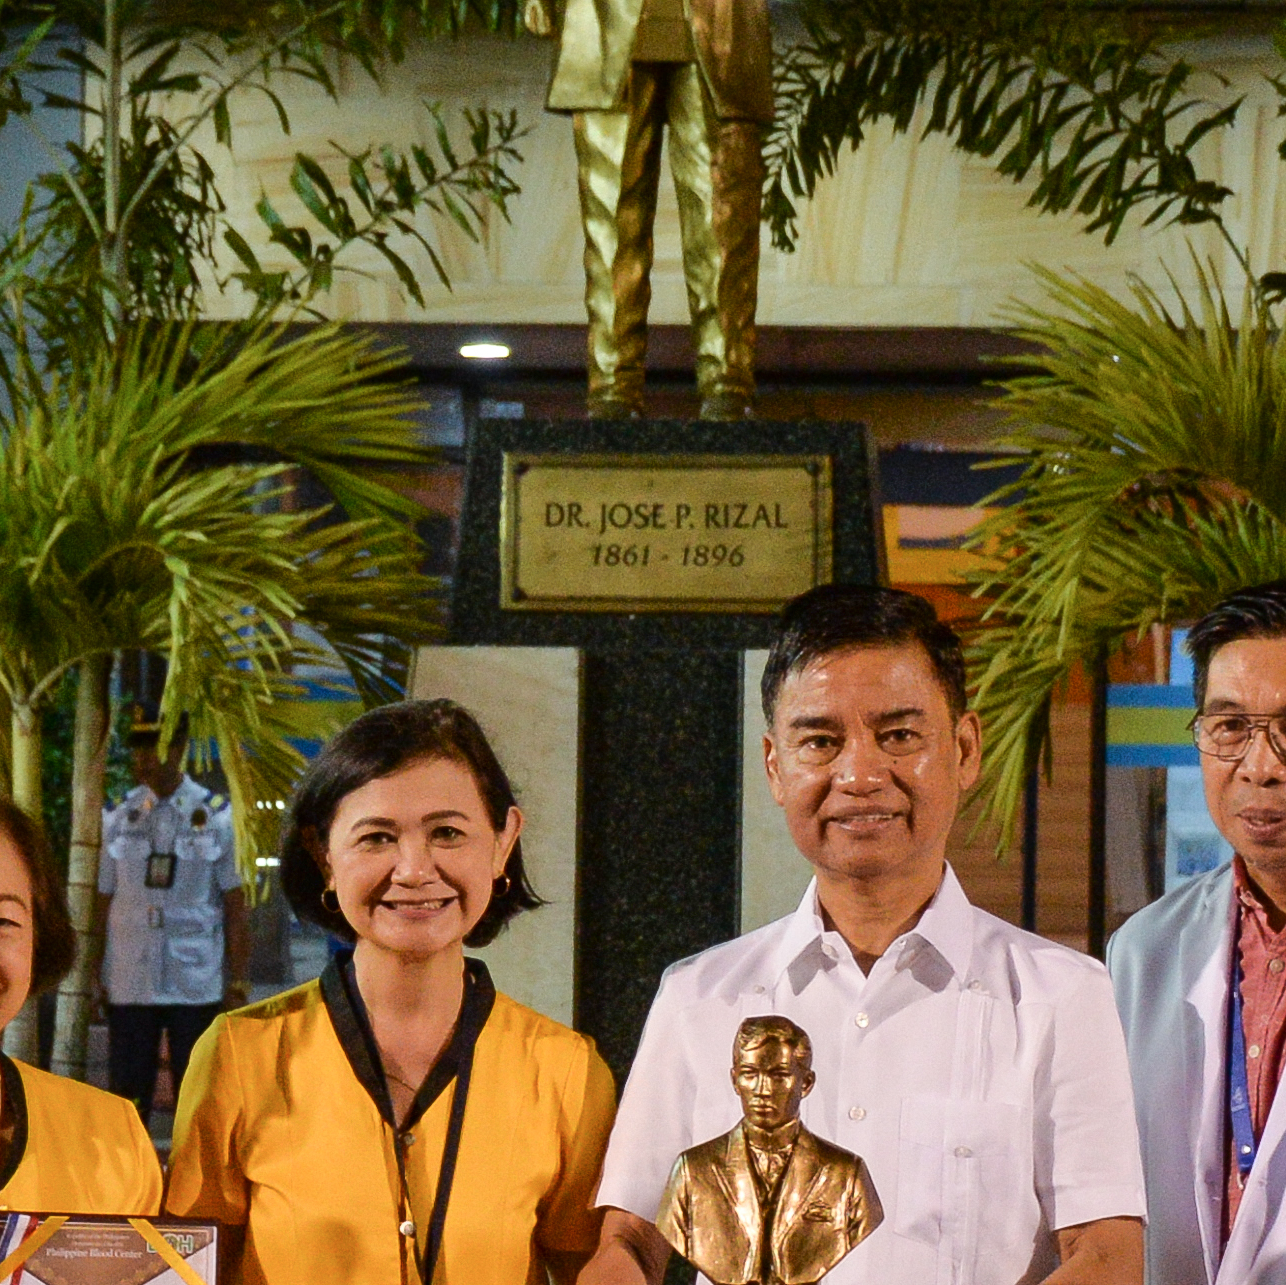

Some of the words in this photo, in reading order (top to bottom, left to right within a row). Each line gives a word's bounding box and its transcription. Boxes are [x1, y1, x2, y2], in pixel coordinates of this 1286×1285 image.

[545, 502, 591, 528] DR.
[599, 502, 666, 535] JOSE
[676, 502, 695, 529] P.
[704, 502, 788, 529] RIZAL
[592, 543, 651, 567] 1861
[682, 543, 746, 567] 1896
[46, 1248, 89, 1259] Philippine
[90, 1249, 113, 1257] Blood
[115, 1250, 143, 1259] Center
